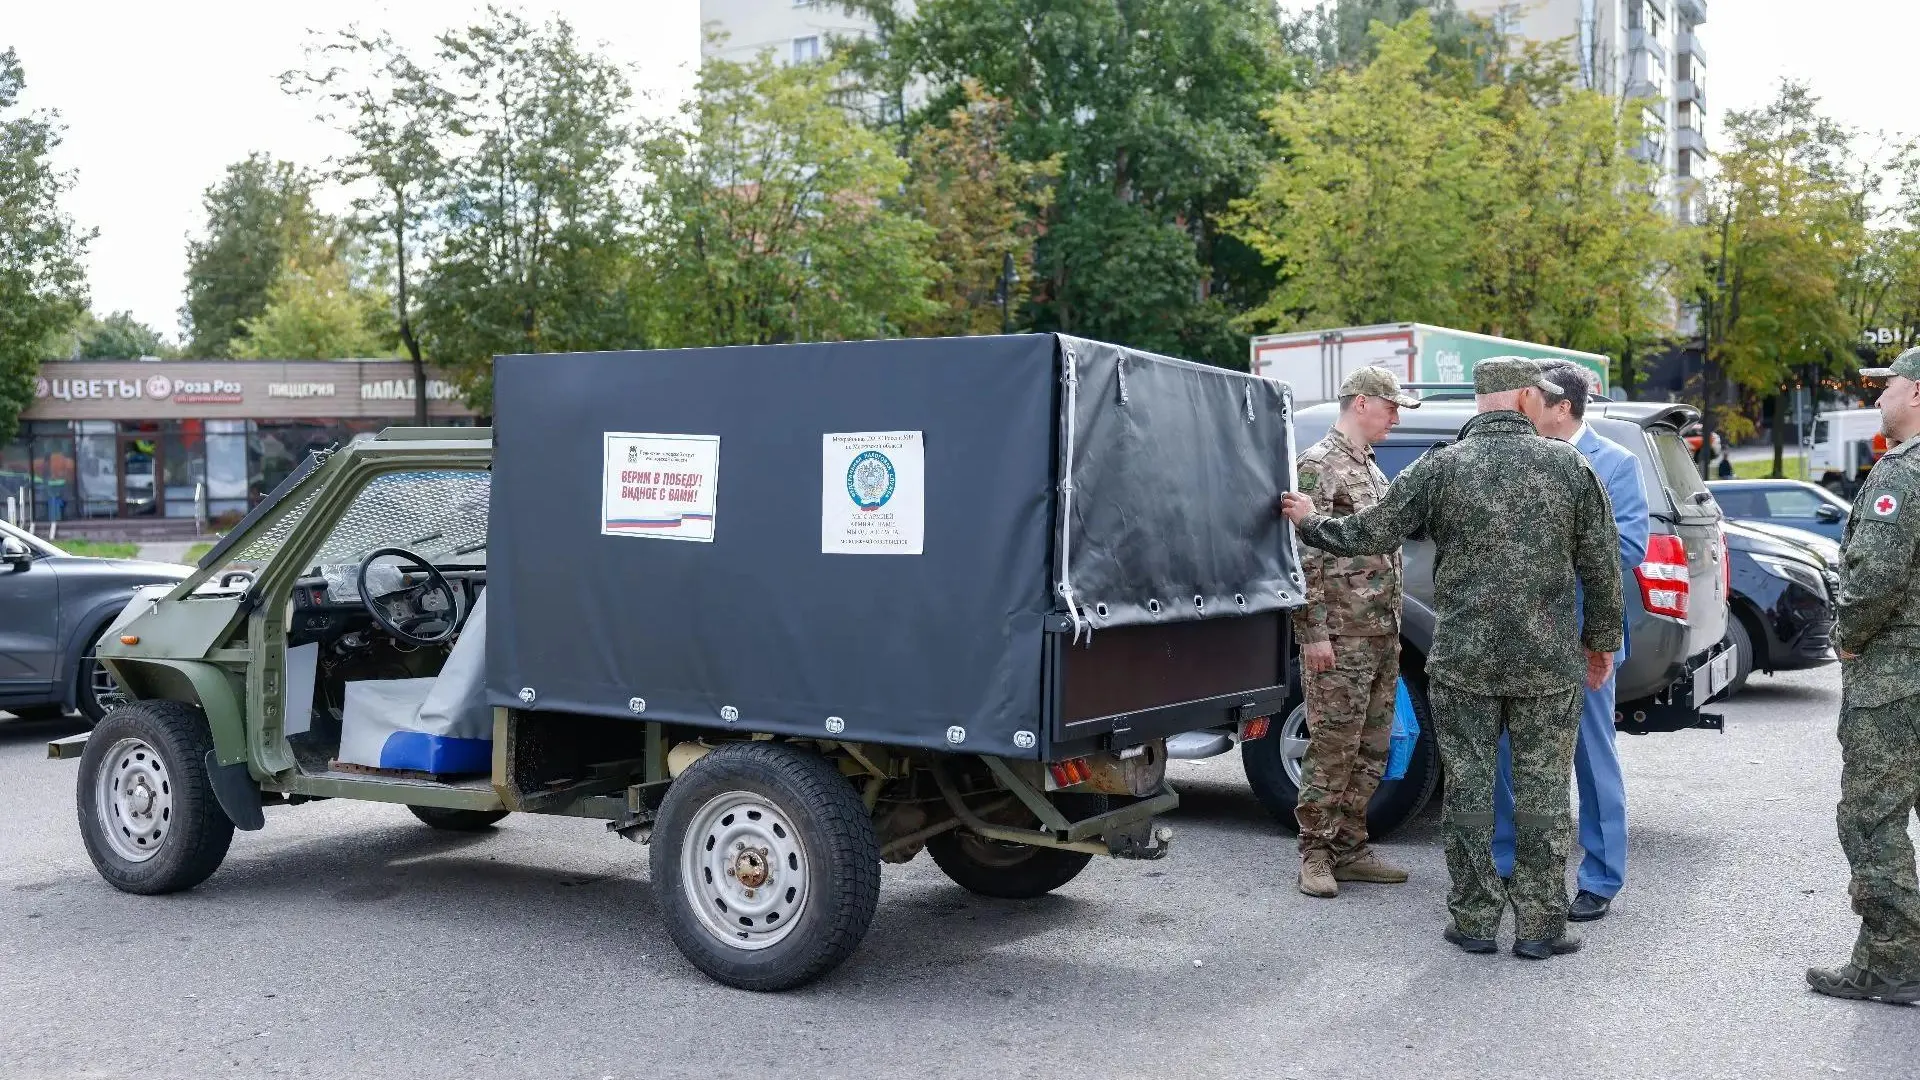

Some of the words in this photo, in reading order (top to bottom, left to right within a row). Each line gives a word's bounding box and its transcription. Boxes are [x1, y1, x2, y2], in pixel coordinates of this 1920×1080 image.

[52, 378, 142, 401] ЦВЕТЫ
[174, 379, 210, 394] Роза
[213, 379, 241, 394] Роз
[268, 383, 336, 398] ПИЦЦЕРИЯ
[360, 379, 406, 399] ПАПА
[621, 470, 651, 484] ВЕРИМ
[653, 472, 660, 485] В
[662, 472, 703, 488] ПОБЕДУ!
[621, 486, 658, 501] ВИДНОЕ
[659, 487, 666, 500] С
[668, 489, 698, 502] ВАМИ!
